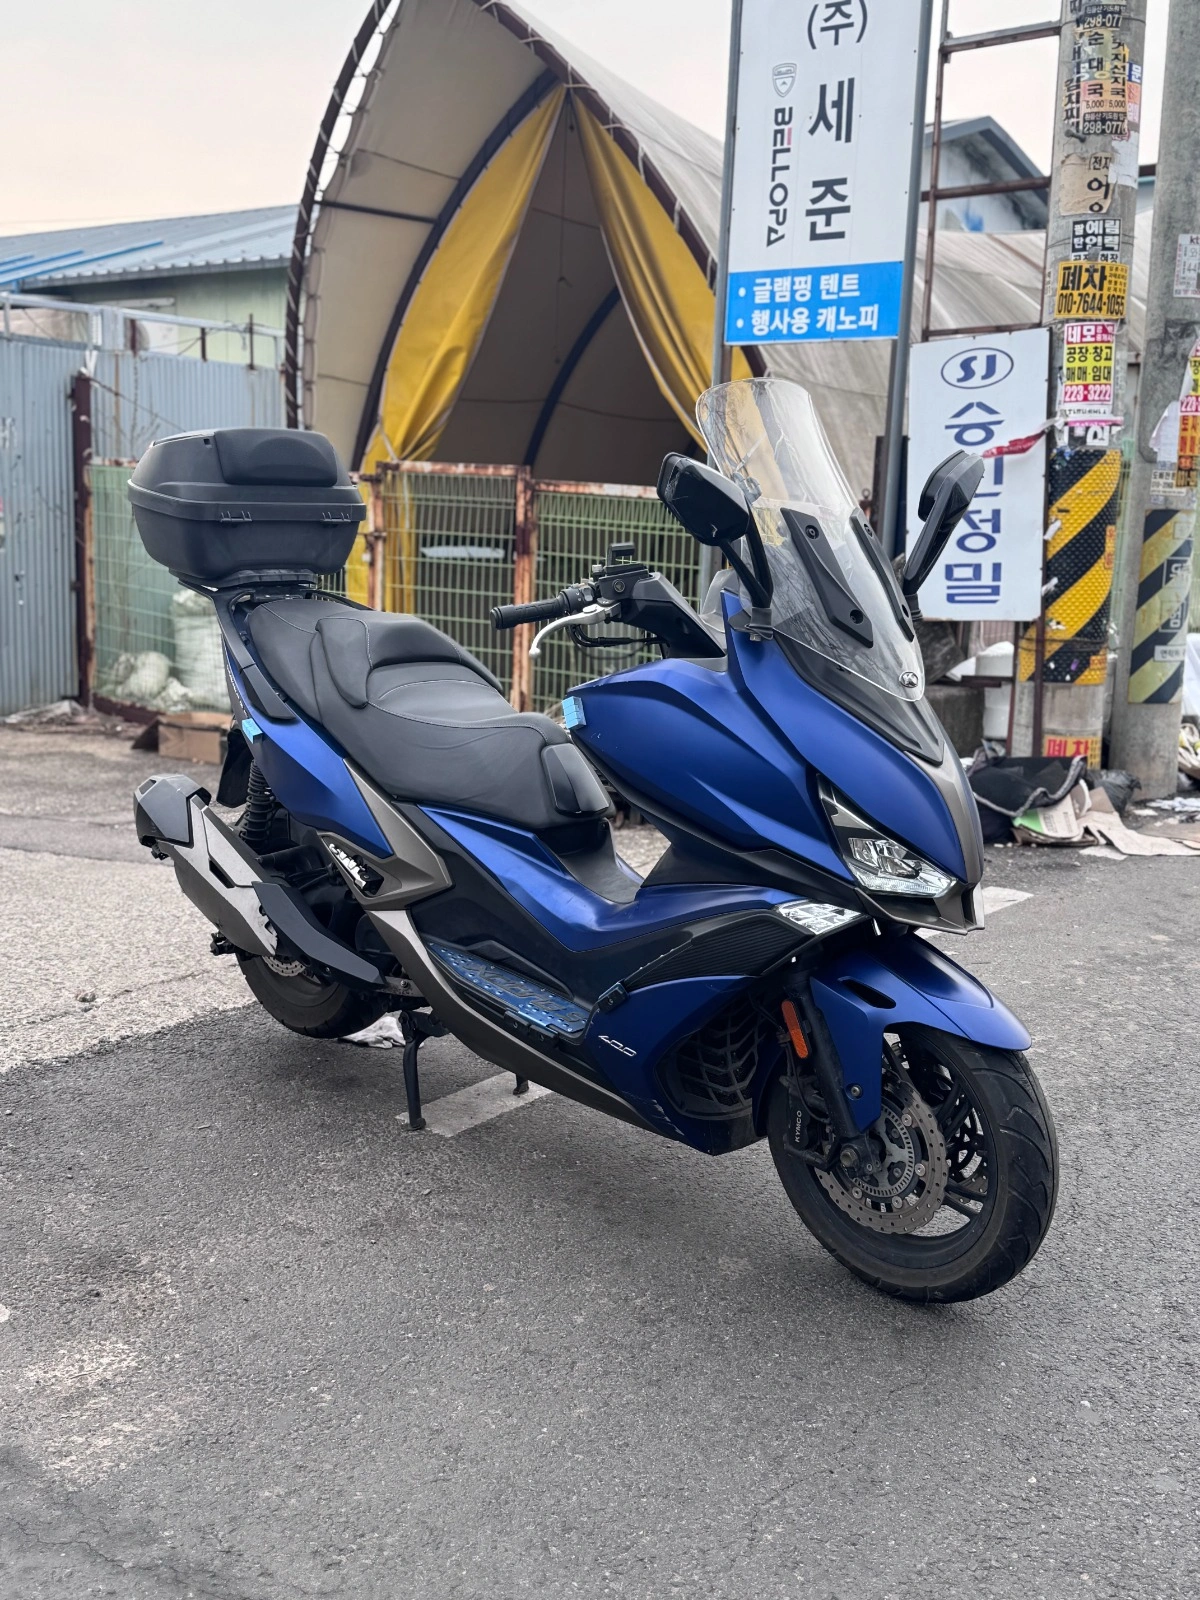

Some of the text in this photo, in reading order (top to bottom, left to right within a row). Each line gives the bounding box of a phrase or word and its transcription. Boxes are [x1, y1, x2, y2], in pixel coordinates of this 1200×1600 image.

[752, 272, 861, 303] 글램핑 텐트
[1060, 264, 1107, 292] 폐차
[751, 304, 879, 336] 행사용 캐노피
[1068, 325, 1096, 344] 네모
[956, 354, 997, 383] SJ
[794, 1110, 803, 1143] KYMCO
